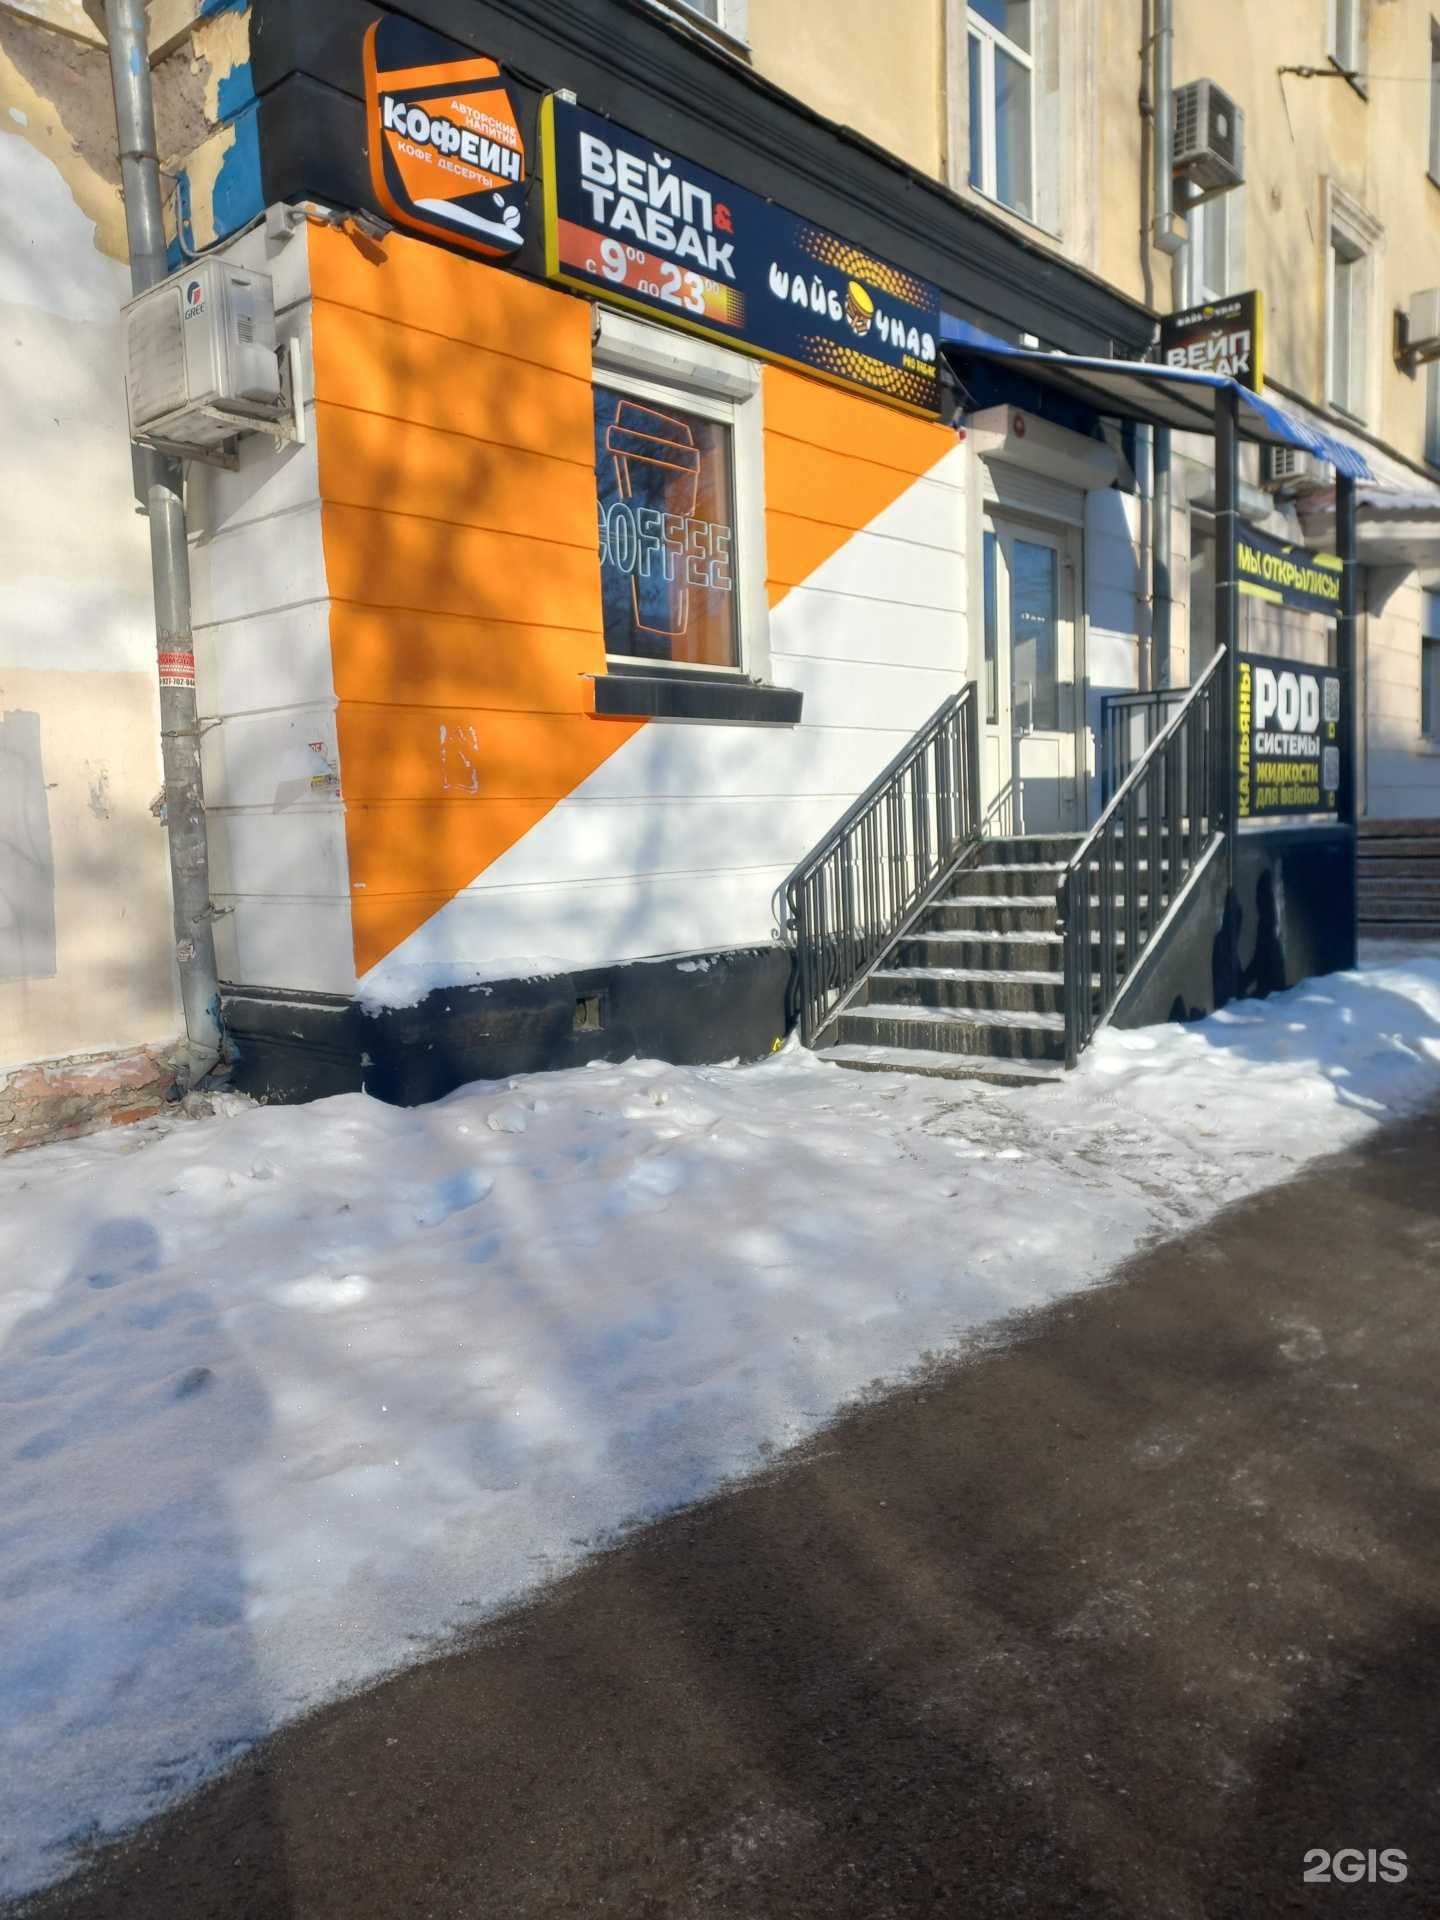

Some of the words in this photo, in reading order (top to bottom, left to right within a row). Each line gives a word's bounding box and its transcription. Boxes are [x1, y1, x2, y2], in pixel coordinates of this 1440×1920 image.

[451, 100, 516, 135] АВТОРСКИЕ
[465, 116, 517, 145] НАПИТКИ
[384, 96, 521, 182] КОФЕИН
[398, 141, 432, 164] КОФЕ
[438, 160, 493, 188] ДЕСЕРТЫ
[580, 131, 713, 233] ВЕЙП
[581, 179, 736, 279] ТАБАК
[185, 304, 204, 320] GREE
[1167, 329, 1250, 369] ВЕЙП
[1238, 542, 1261, 576] МЫ
[1255, 667, 1320, 733] POD
[1240, 662, 1251, 817] КАЛЬЯНЫ
[1256, 733, 1320, 757] СИСТЕМЫ
[1257, 762, 1319, 784] ЖИДКОСТИ
[1256, 787, 1279, 809] ДЛЯ
[1281, 783, 1319, 806] ВЕЙПОВ
